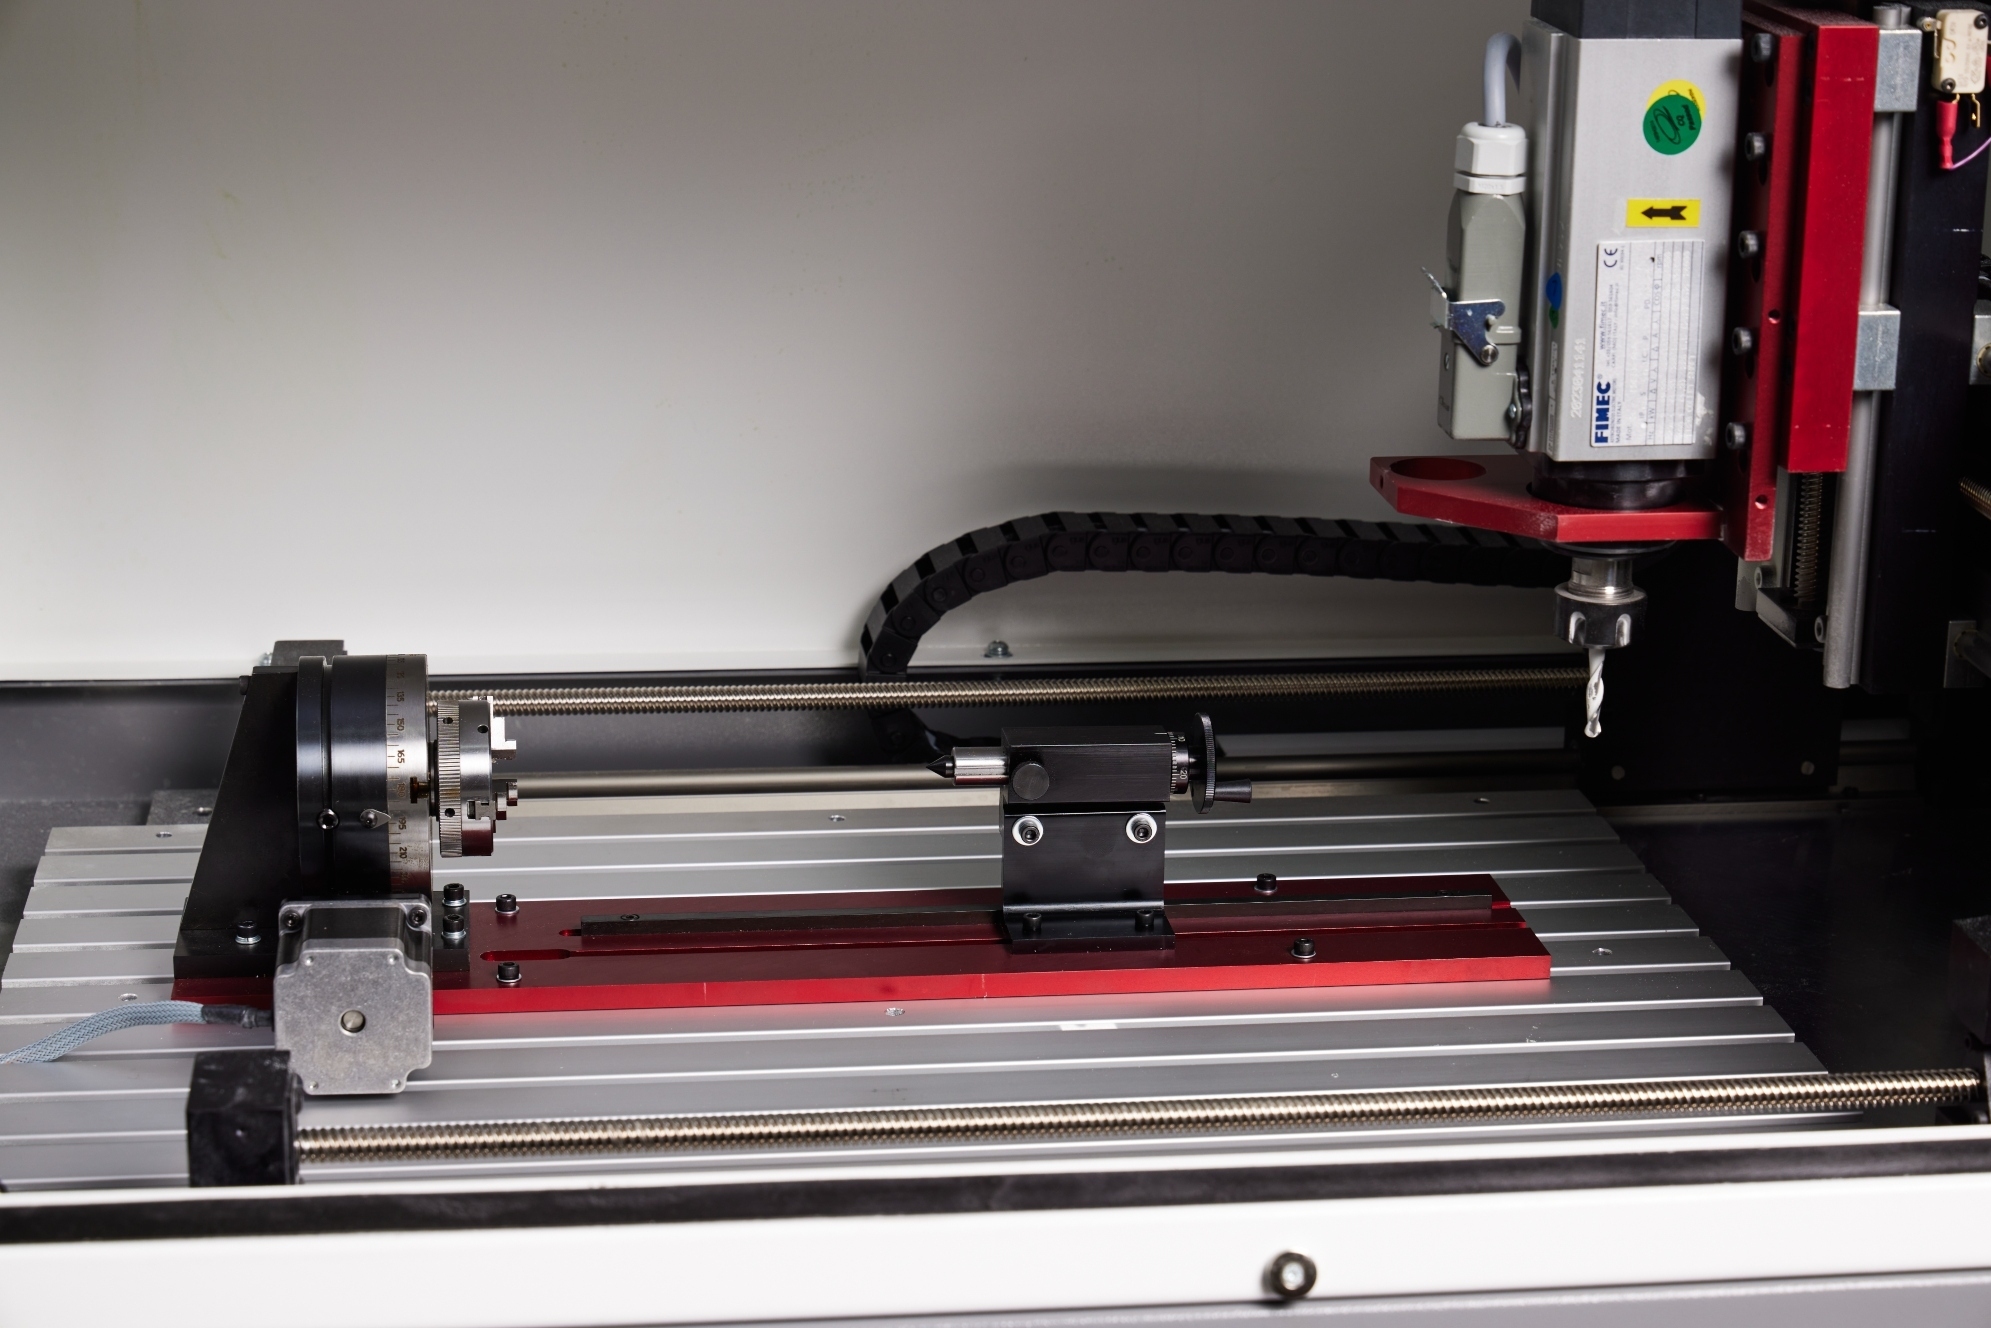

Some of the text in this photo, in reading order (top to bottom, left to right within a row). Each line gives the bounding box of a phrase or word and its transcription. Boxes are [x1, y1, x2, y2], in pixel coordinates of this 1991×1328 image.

[1599, 301, 1607, 350] www.fimec.it
[396, 691, 405, 702] 135
[396, 717, 405, 732] 150
[397, 749, 405, 764] 165
[1180, 769, 1187, 779] 20
[398, 816, 407, 830] 195
[399, 847, 407, 859] 210
